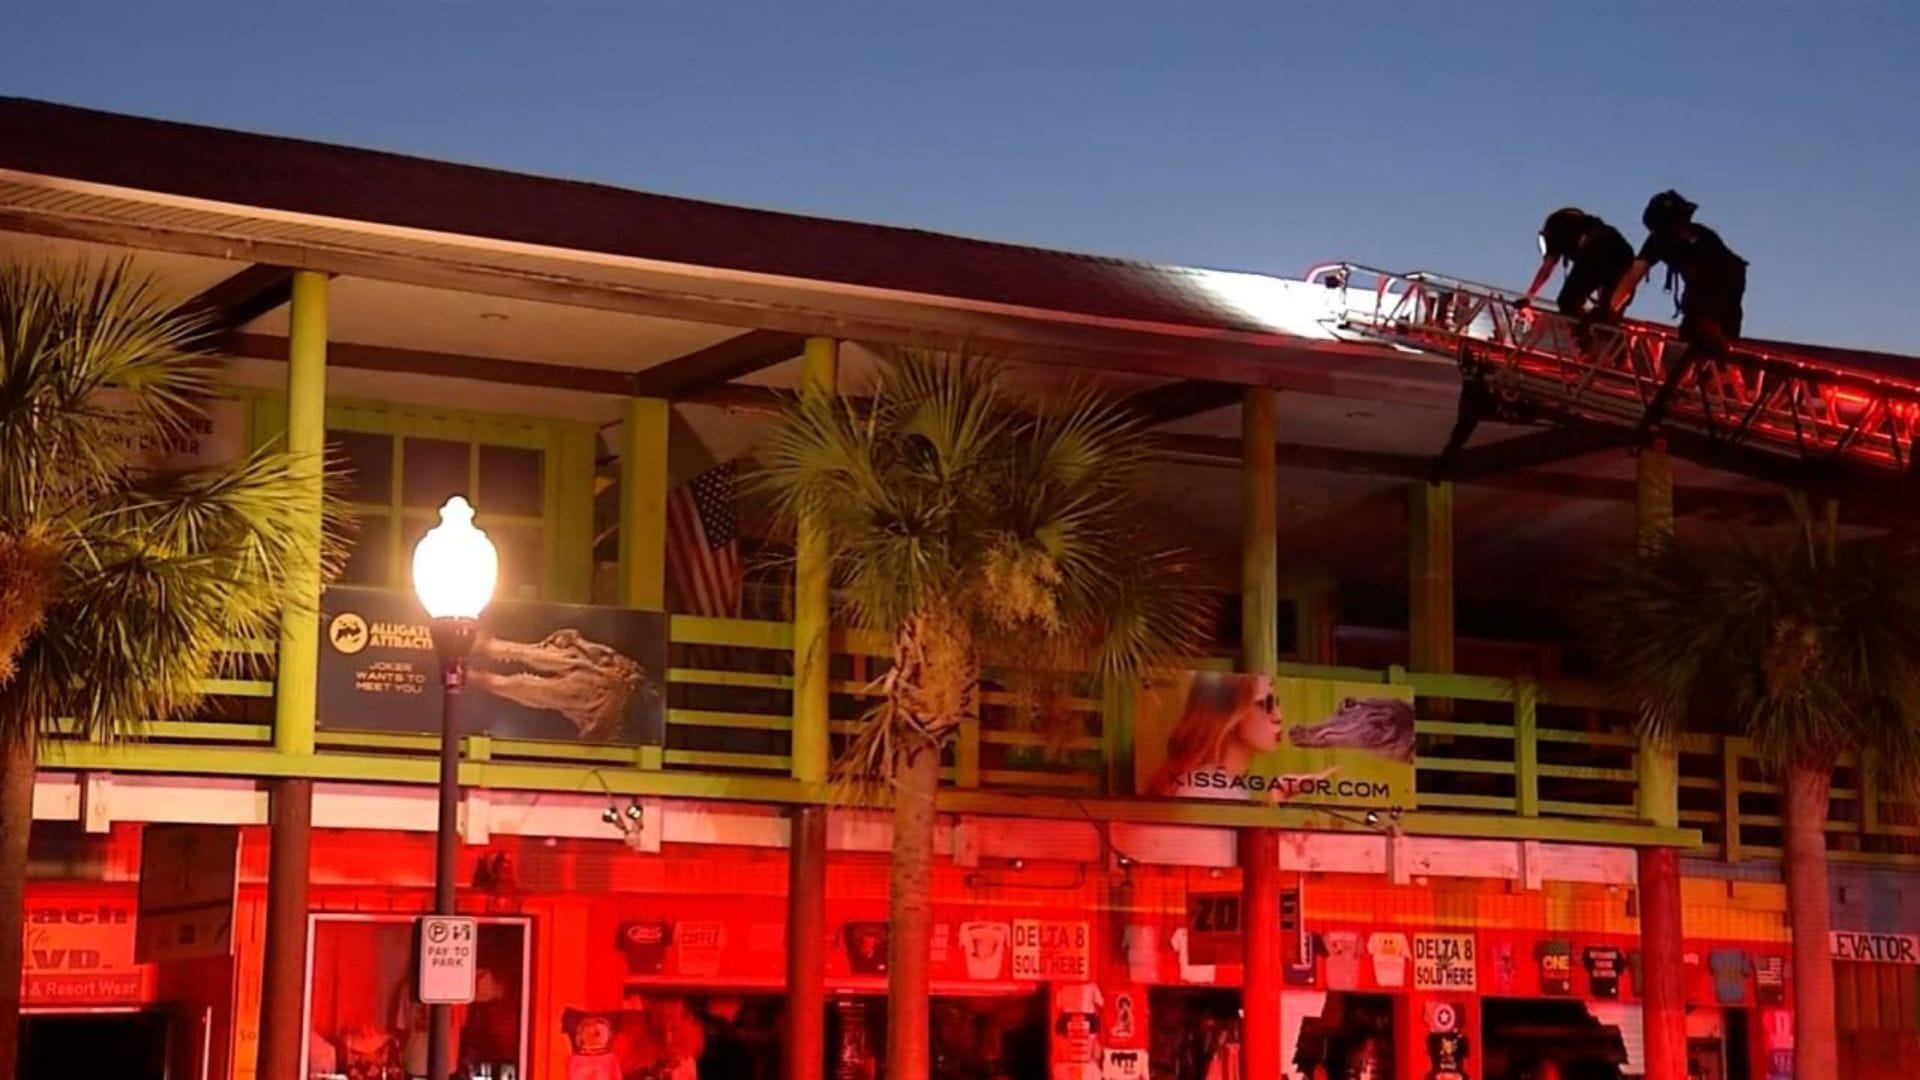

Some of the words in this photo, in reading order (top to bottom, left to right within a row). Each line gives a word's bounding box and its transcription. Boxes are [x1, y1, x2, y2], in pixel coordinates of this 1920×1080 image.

[369, 662, 413, 672] JOKER
[356, 671, 404, 682] WANTS
[407, 674, 426, 684] TO
[356, 681, 390, 691] MEET
[395, 683, 423, 694] YOU
[1168, 772, 1390, 798] KISSAGATOR.COM
[24, 905, 128, 925] ach
[1015, 925, 1070, 948] DELTA
[1076, 926, 1085, 949] 8
[428, 946, 448, 955] PAY
[455, 946, 469, 957] TO
[1416, 938, 1461, 961] DELTA
[1465, 939, 1473, 960] 8
[1829, 933, 1917, 962] EVATOR
[26, 949, 113, 970] VD.
[432, 957, 464, 967] PARK
[1015, 954, 1047, 975] SOLD
[1051, 955, 1085, 976] HERE
[1416, 966, 1443, 985] SOLD
[1446, 967, 1474, 986] HERE
[30, 982, 42, 996] &
[47, 981, 96, 997] Resort
[99, 980, 138, 997] Wear
